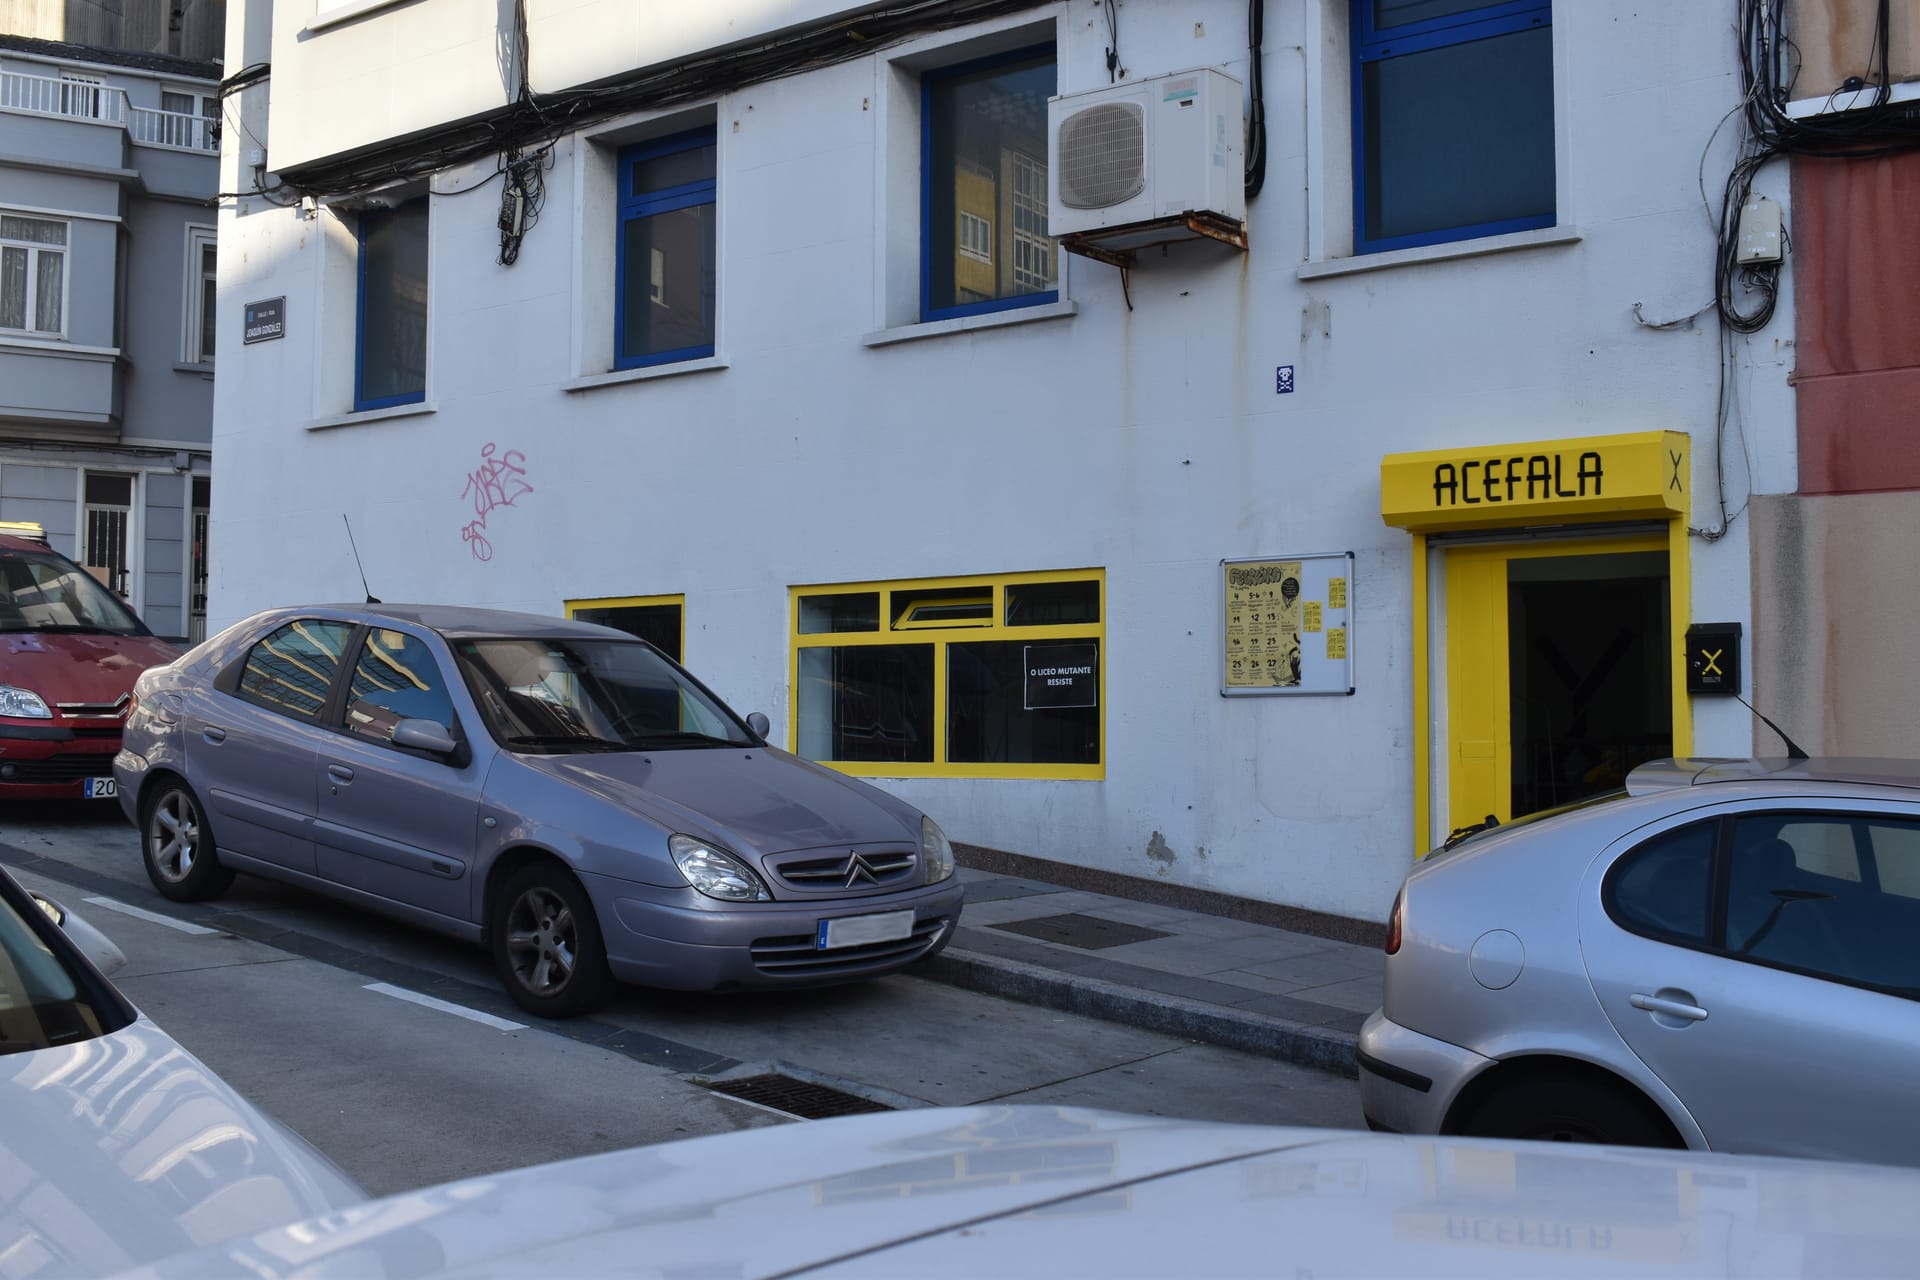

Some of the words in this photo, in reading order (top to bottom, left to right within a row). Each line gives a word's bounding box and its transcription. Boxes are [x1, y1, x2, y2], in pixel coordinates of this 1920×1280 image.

[1433, 452, 1603, 506] ACEFALA
[1252, 613, 1260, 621] 12
[1232, 660, 1241, 668] 25
[1038, 668, 1056, 676] LICEO
[1057, 667, 1091, 675] MUTANTE
[1047, 678, 1073, 686] RESISTE
